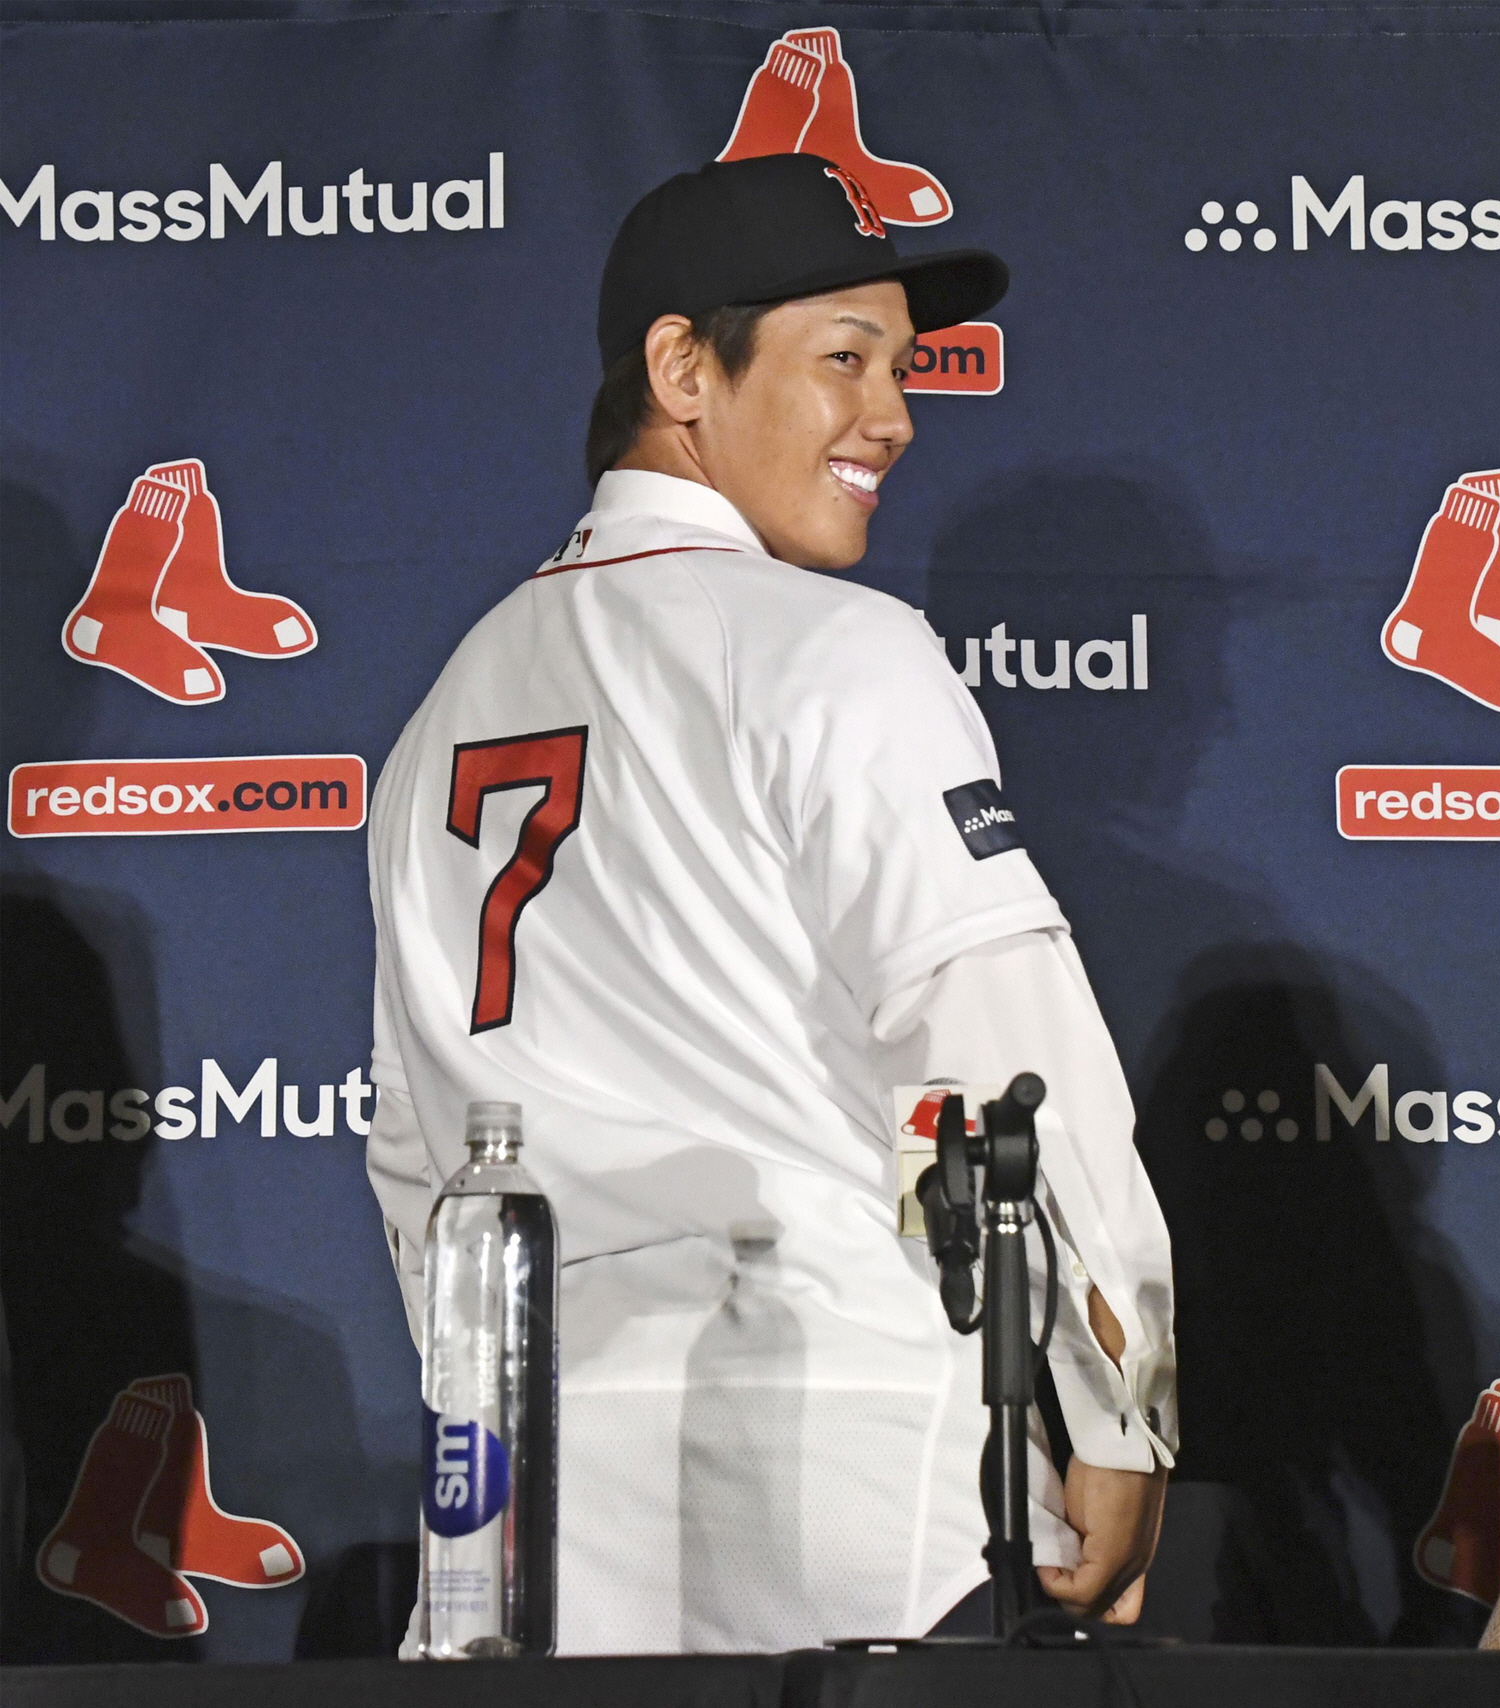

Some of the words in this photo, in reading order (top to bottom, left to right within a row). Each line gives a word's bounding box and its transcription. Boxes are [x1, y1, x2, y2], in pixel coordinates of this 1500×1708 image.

[0, 151, 504, 242] MassMutual
[915, 609, 1149, 691] utual
[26, 776, 348, 818] redsox.com
[447, 726, 589, 1036] 7
[0, 1056, 381, 1144] MassMut
